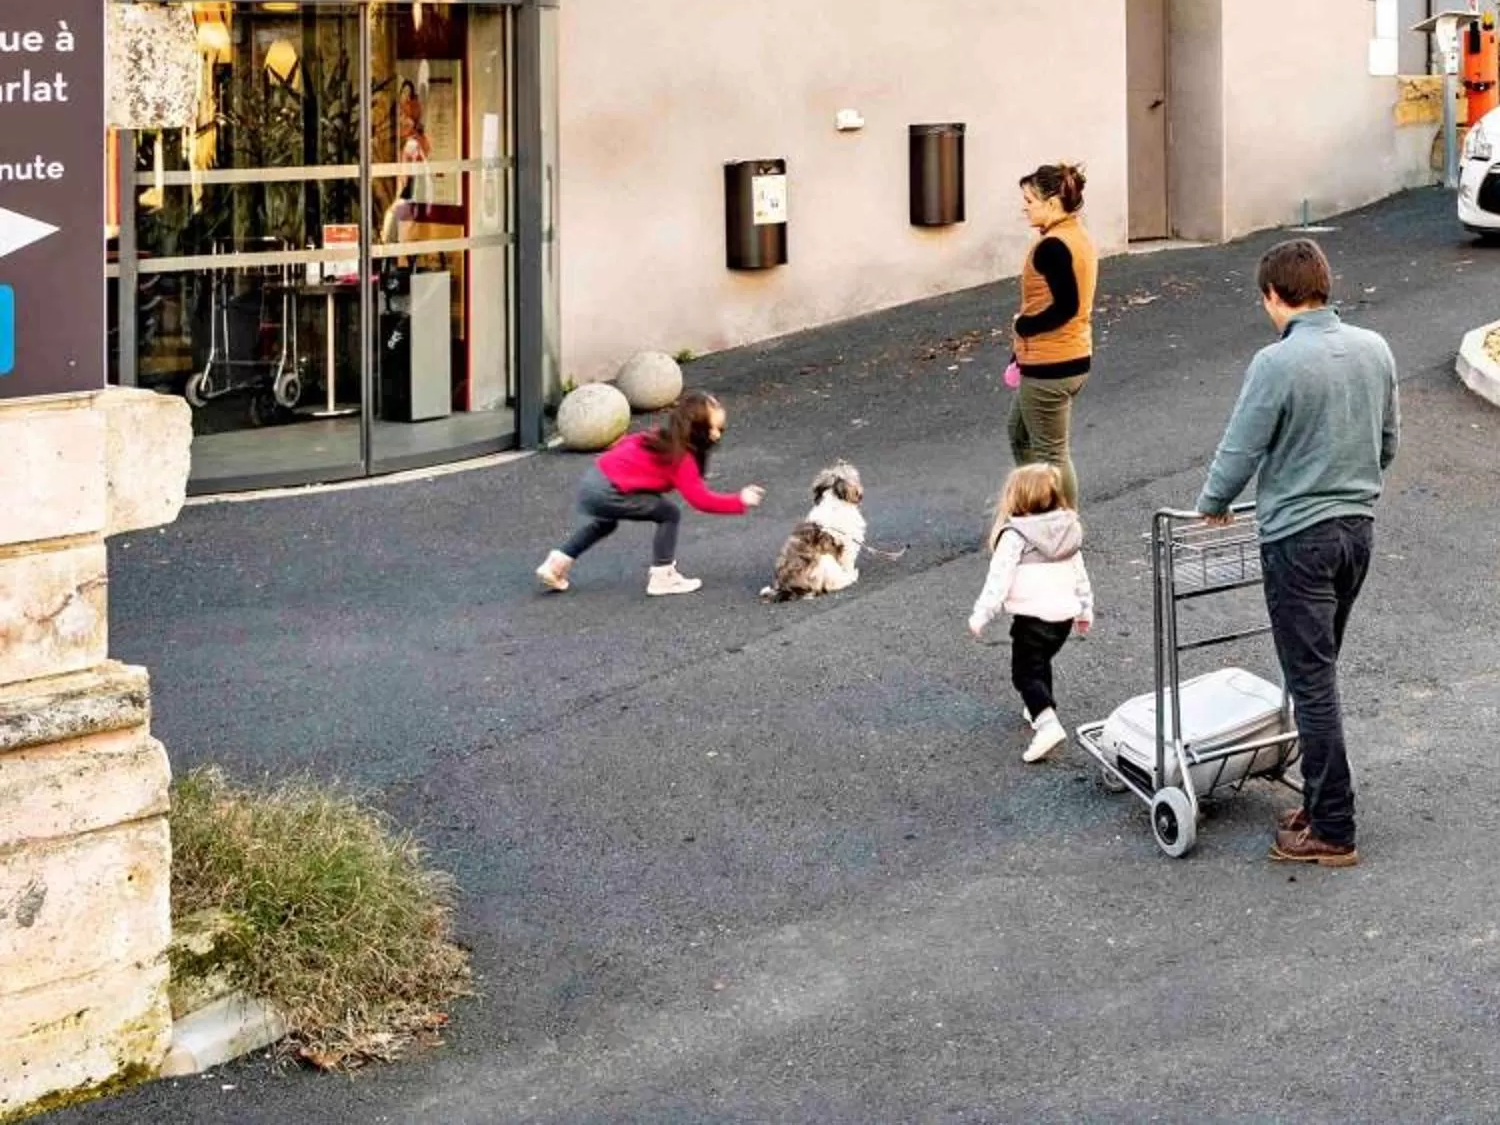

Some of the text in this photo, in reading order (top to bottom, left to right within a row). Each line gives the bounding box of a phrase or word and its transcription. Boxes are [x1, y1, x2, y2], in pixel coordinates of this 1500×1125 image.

[0, 19, 75, 52] ue à
[0, 68, 69, 103] rlat
[0, 154, 65, 180] nute
